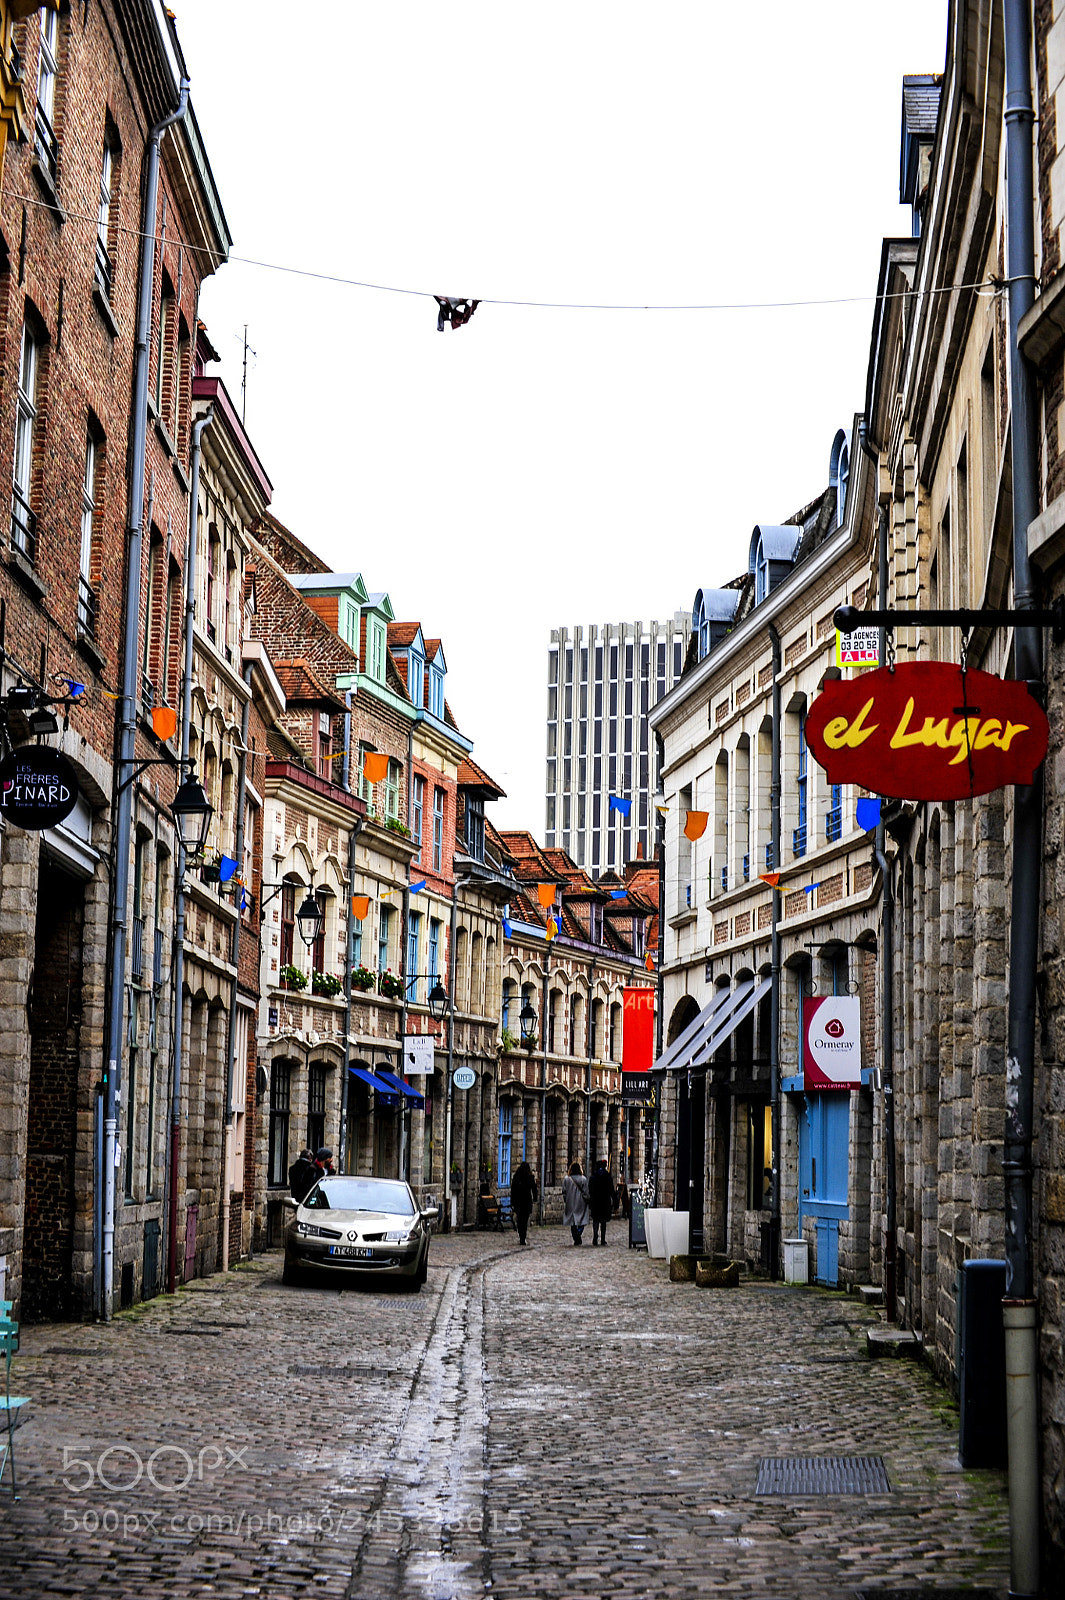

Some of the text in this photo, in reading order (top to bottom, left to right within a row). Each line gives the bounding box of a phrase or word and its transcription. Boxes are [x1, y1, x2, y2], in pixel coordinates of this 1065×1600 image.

[841, 640, 877, 650] 03 20 52
[844, 651, 854, 661] A
[823, 696, 1030, 765] el Lugar
[16, 765, 32, 773] LES
[16, 772, 59, 785] FRÈRES
[624, 992, 653, 1010] Art
[814, 1038, 855, 1051] Ormeray
